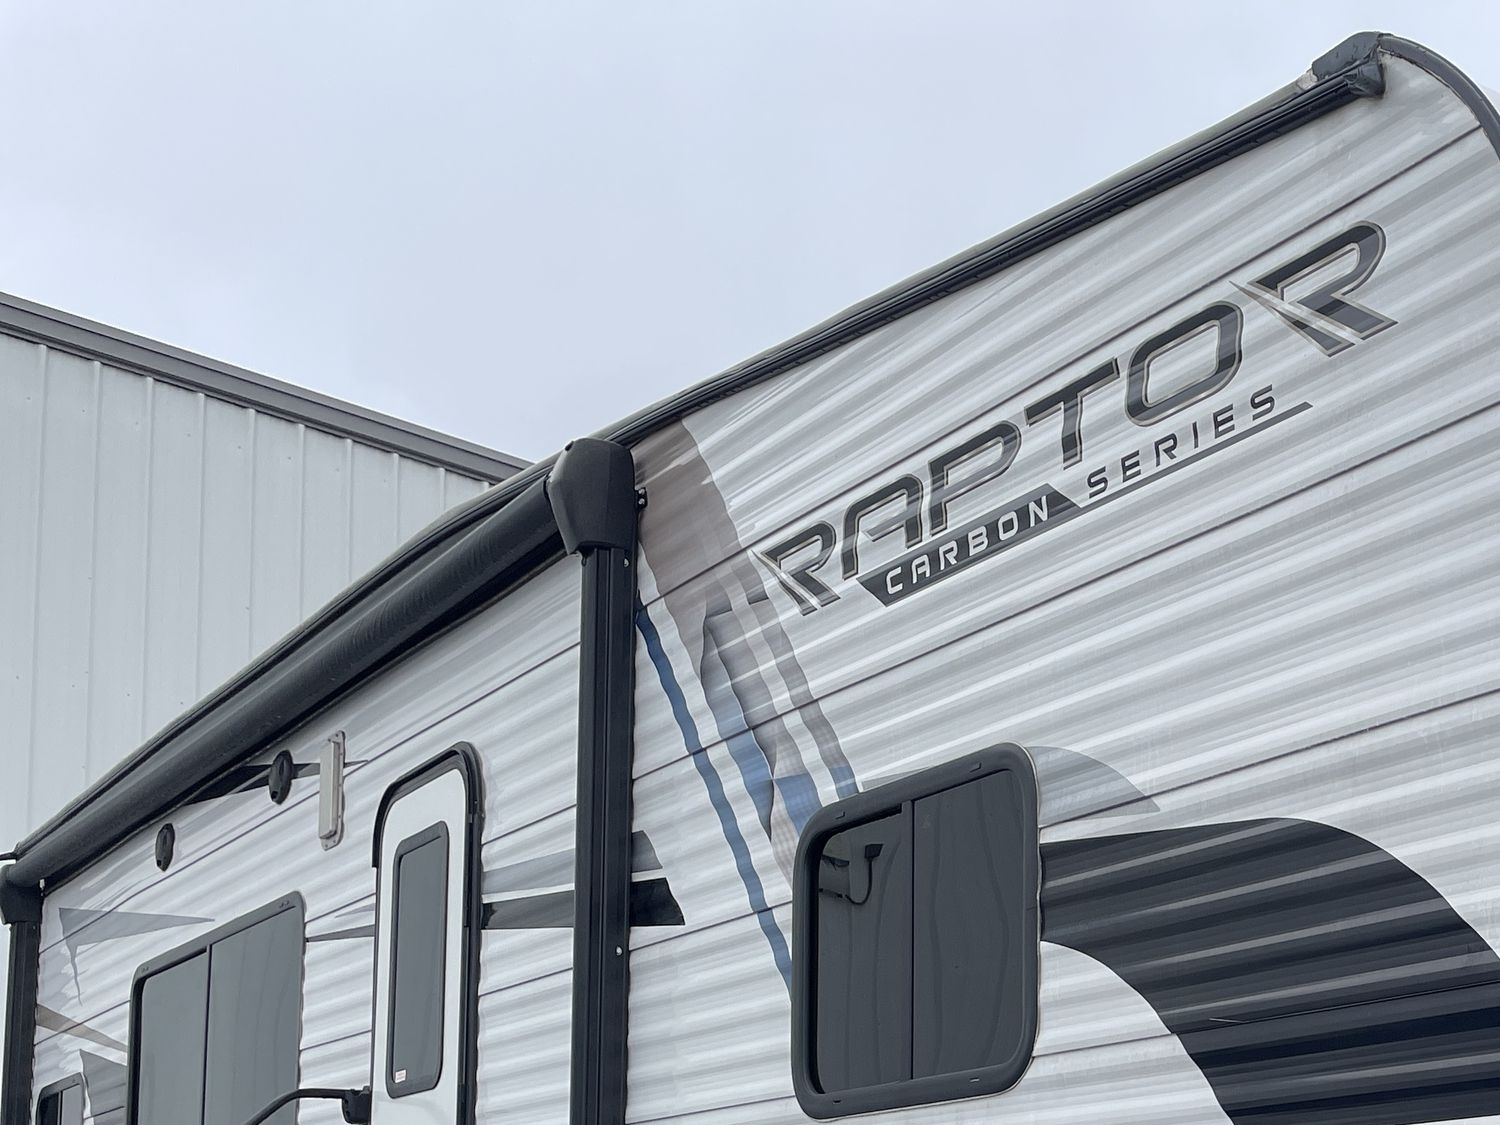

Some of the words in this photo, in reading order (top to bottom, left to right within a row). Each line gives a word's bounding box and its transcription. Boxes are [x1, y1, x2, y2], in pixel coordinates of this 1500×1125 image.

[753, 220, 1398, 616] RAPTOR
[884, 494, 1051, 595] CARBON
[1087, 383, 1277, 499] SERIES
